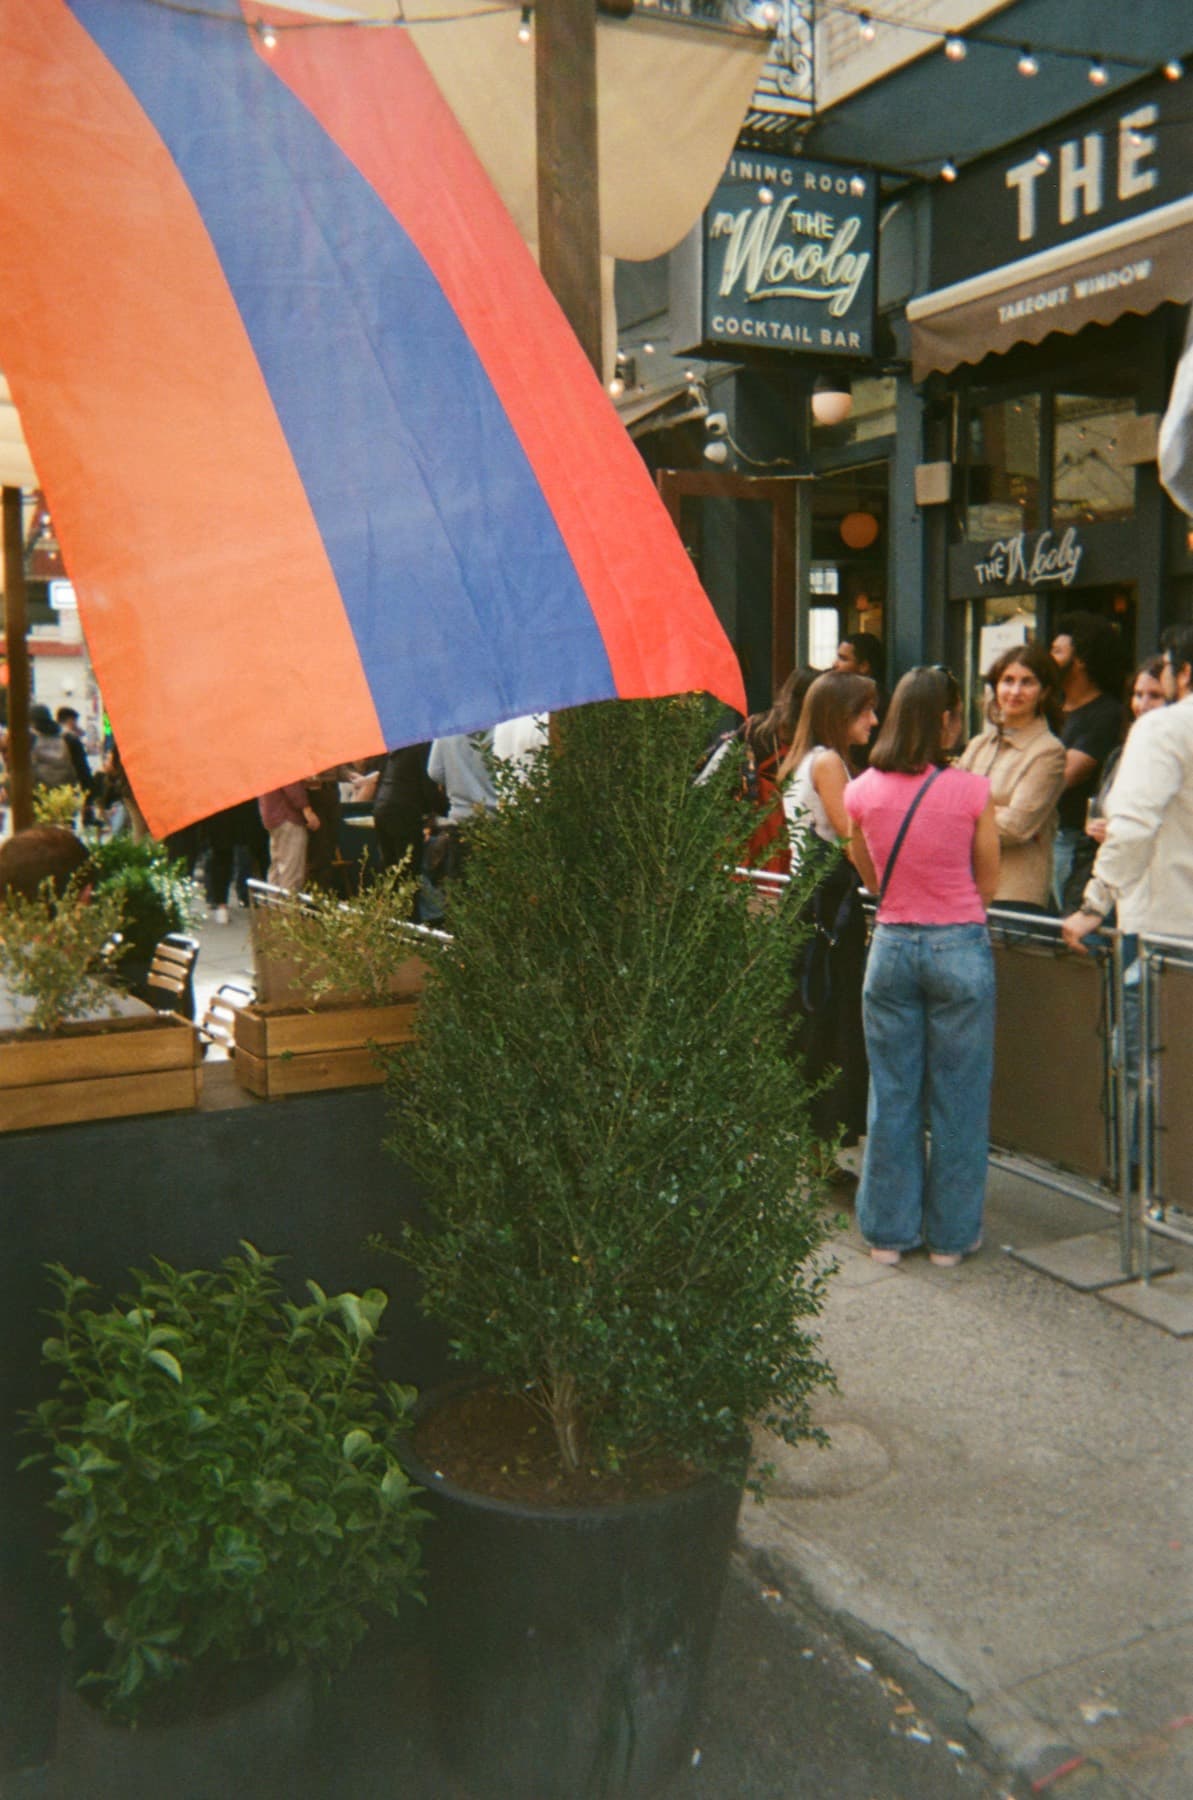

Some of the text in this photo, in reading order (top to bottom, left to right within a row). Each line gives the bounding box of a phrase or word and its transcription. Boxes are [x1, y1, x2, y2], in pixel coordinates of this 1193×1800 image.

[730, 159, 793, 186] INING
[1006, 103, 1159, 241] THE
[790, 211, 835, 239] THE
[710, 194, 870, 318] Wooly
[998, 259, 1153, 324] TAKEOUT WINDOW
[712, 315, 861, 348] COCKTAIL BAR
[975, 556, 1005, 584] THE
